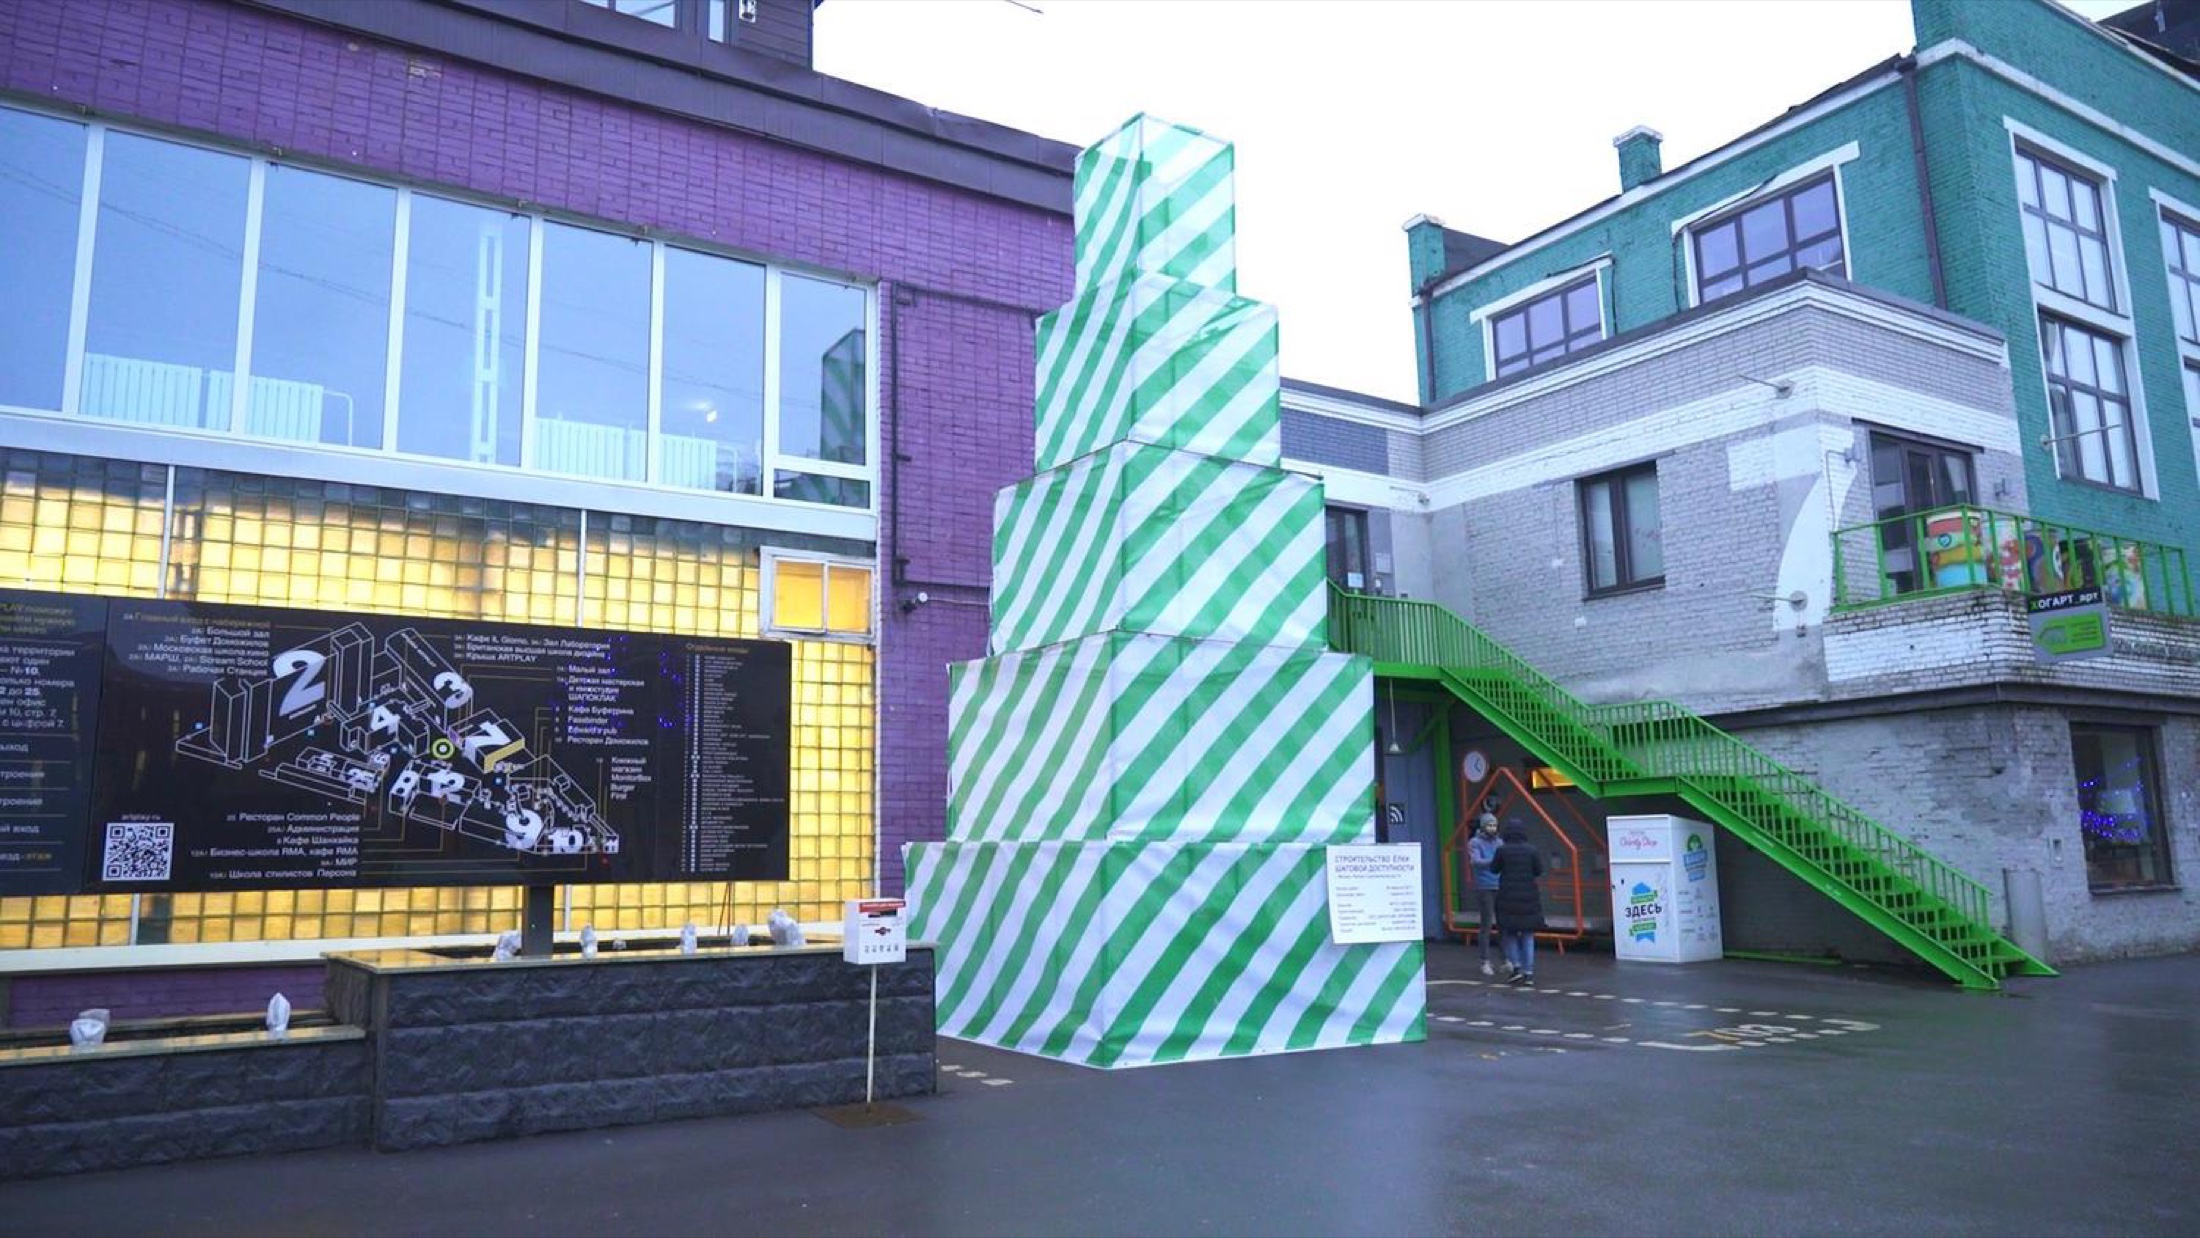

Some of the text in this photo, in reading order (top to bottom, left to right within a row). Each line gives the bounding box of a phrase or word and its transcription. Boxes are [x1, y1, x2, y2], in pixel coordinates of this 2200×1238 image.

[273, 649, 326, 716] 2
[434, 671, 473, 709] 3
[370, 705, 401, 737] 4
[505, 808, 543, 850] 9
[548, 826, 584, 854] 10
[1624, 903, 1663, 918] ЗДЕСЬ
